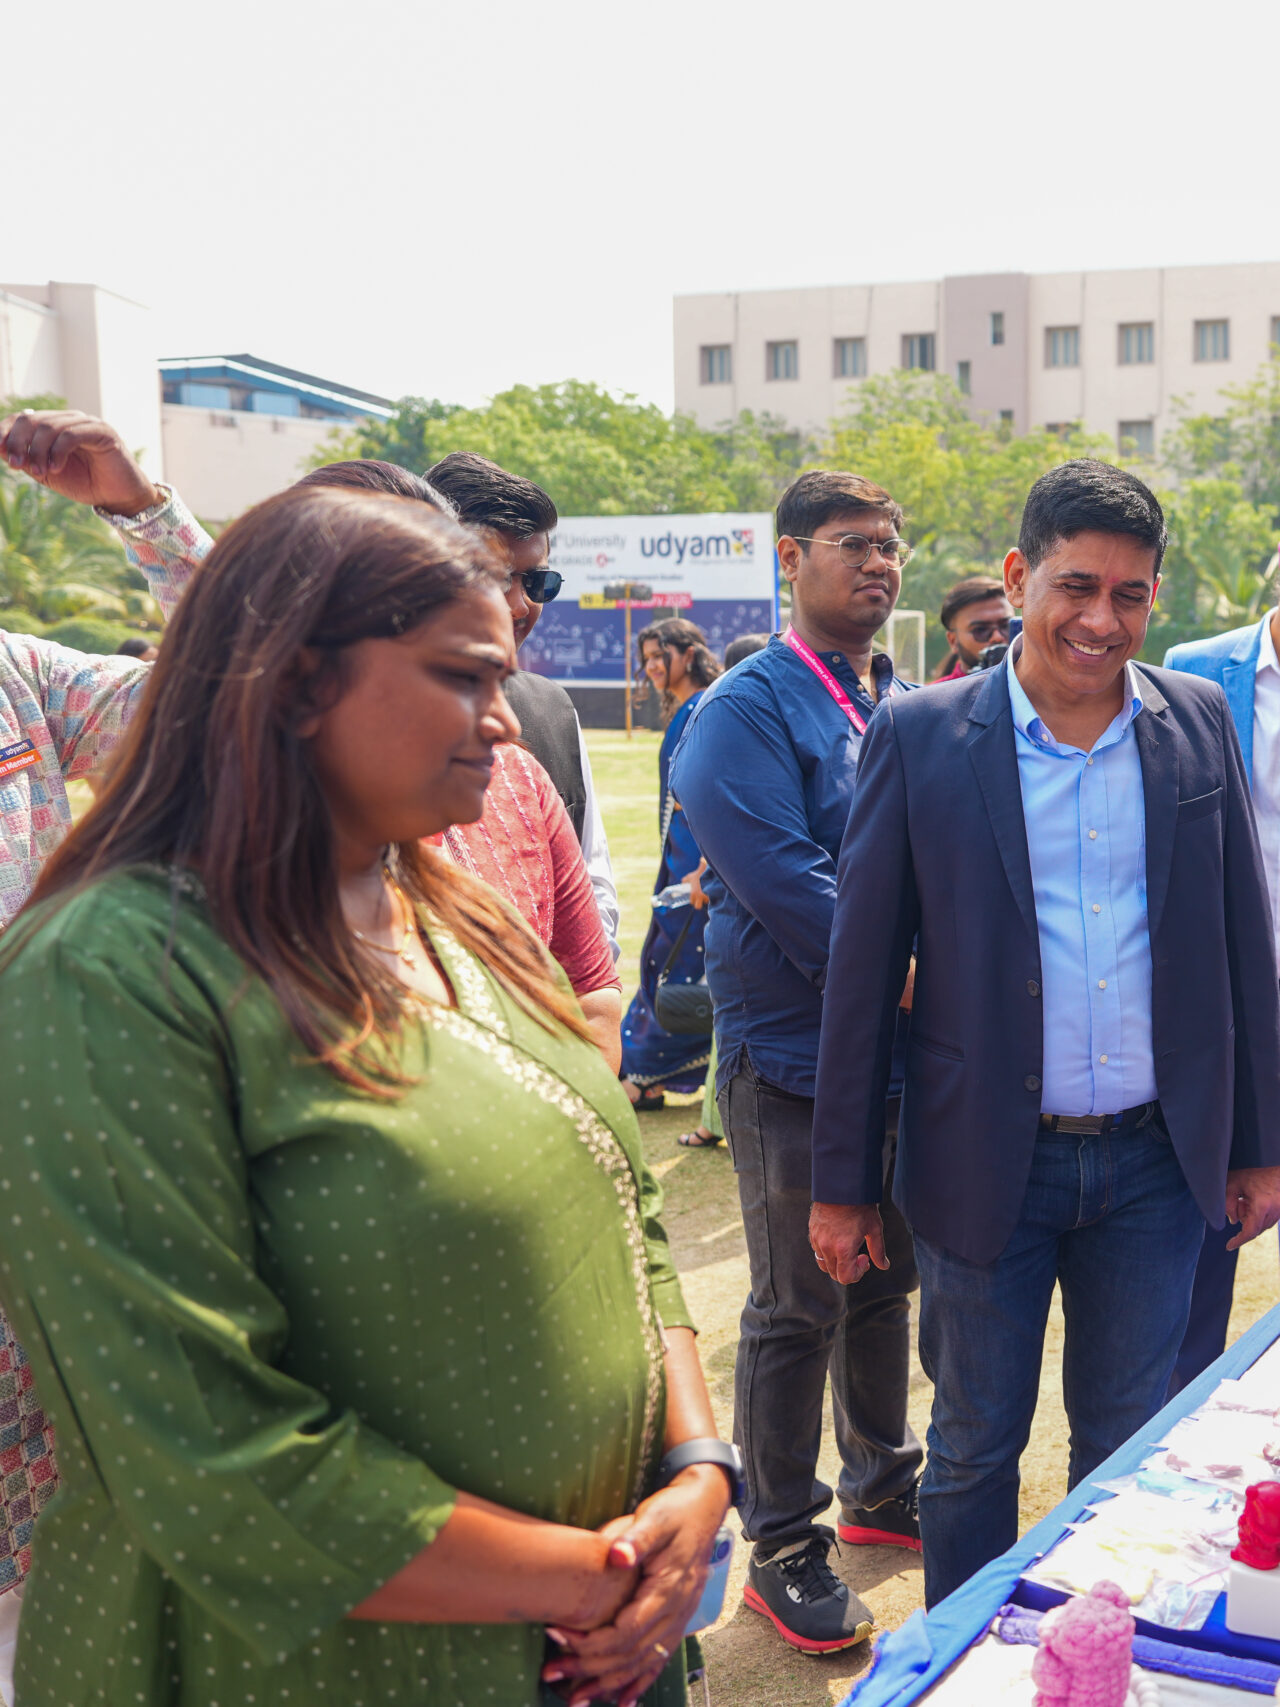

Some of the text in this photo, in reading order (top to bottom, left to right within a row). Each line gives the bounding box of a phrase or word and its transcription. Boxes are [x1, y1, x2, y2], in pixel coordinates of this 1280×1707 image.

[565, 534, 626, 550] University
[640, 531, 730, 564] udyam
[6, 755, 35, 770] Member
